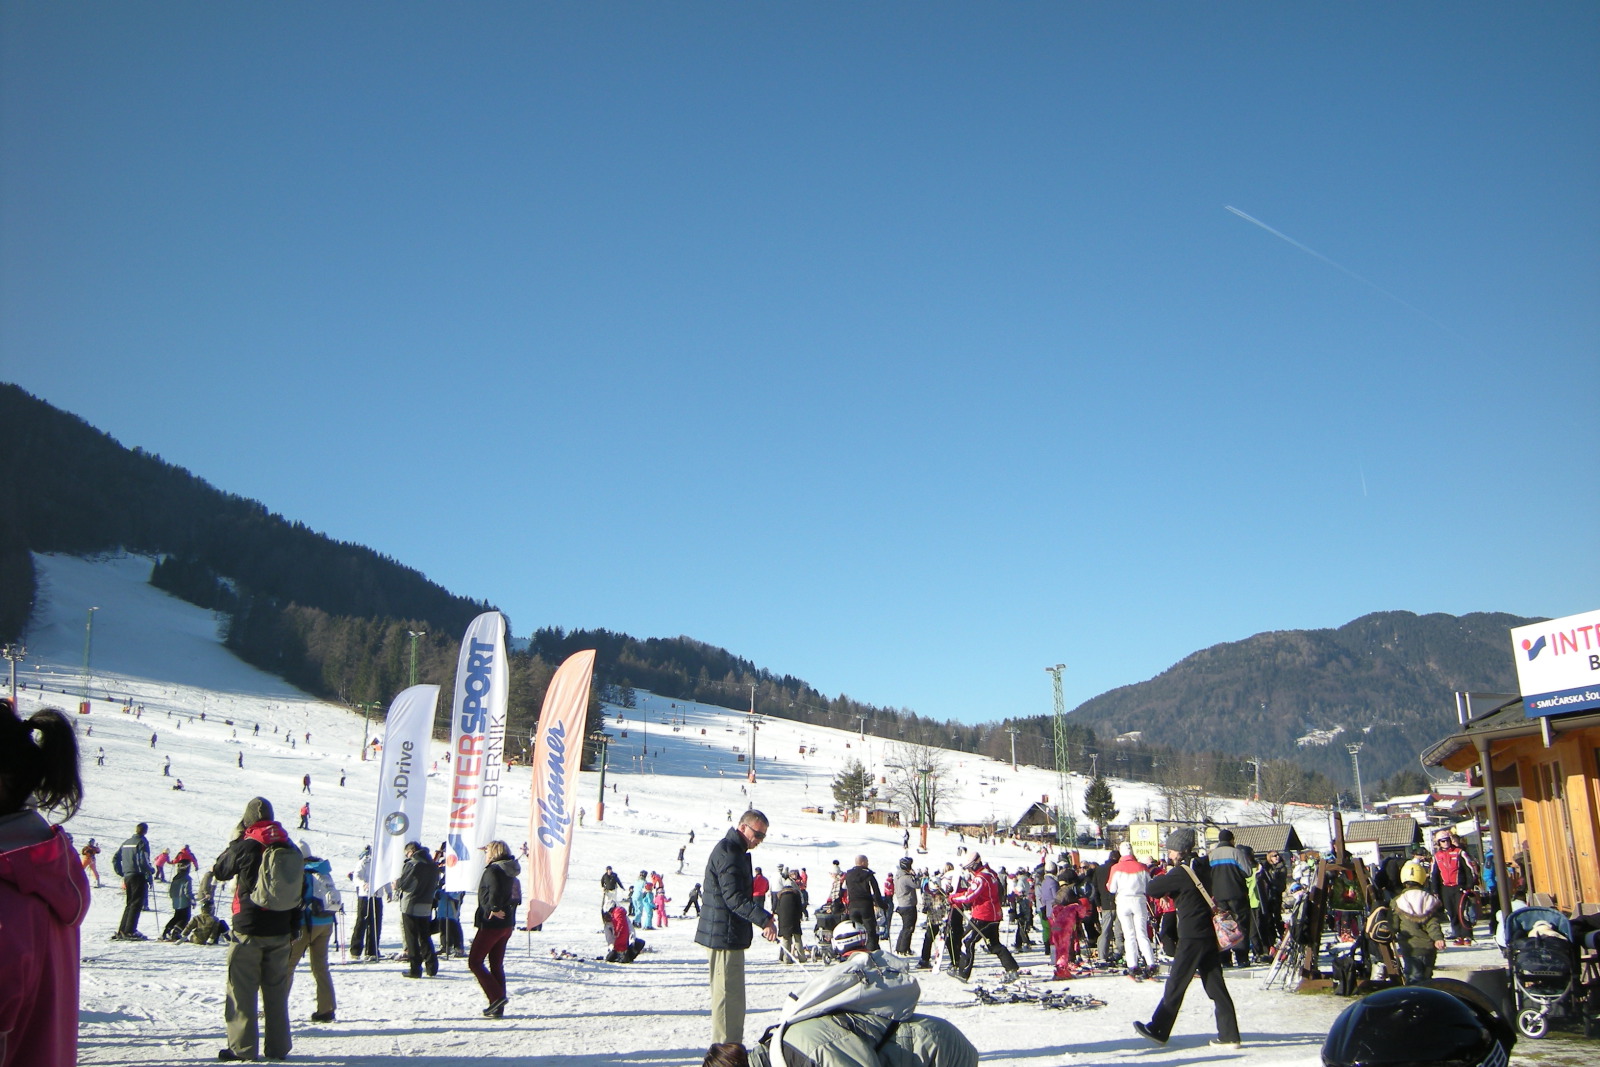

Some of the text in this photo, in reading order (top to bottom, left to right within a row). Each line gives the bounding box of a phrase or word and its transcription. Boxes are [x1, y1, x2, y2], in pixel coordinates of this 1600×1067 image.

[449, 637, 495, 828] INTERSPORT
[1536, 696, 1585, 708] SMUČARSKA
[394, 741, 414, 799] xDrive
[482, 714, 506, 797] BERNIK
[537, 720, 571, 848] Manner
